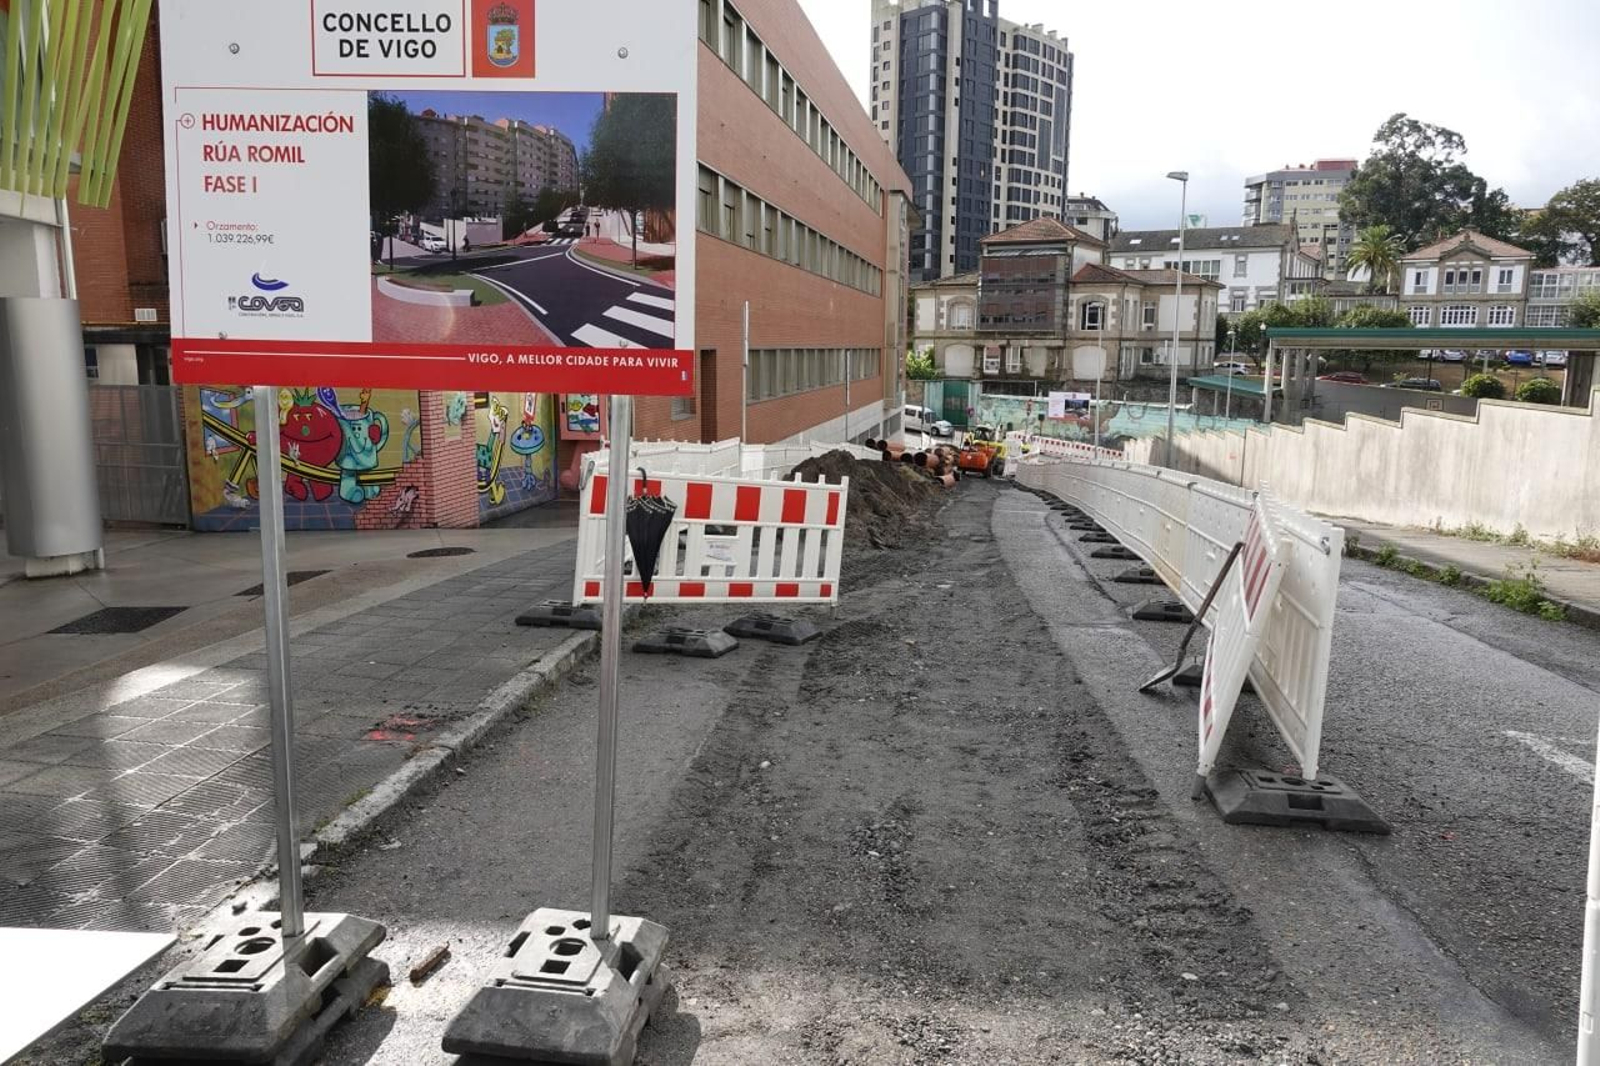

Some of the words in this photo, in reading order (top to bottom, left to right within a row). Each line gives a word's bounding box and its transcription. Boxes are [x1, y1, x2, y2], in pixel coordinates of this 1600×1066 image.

[322, 12, 452, 33] CONCELLO
[339, 39, 370, 58] DE
[378, 39, 437, 59] VIGO
[202, 111, 354, 133] HUMANIZACIÓN
[203, 140, 241, 162] RÚA
[248, 145, 306, 163] ROMIL
[204, 175, 246, 193] FASE
[252, 176, 257, 193] I
[206, 220, 259, 231] Orzamento:
[207, 233, 275, 245] 1.039.226,99€
[468, 353, 502, 365] VIGO,
[506, 354, 515, 364] A
[518, 354, 562, 366] MELLOR
[565, 355, 609, 367] CIDADE
[612, 356, 643, 367] PARA
[647, 357, 678, 368] VIVIR
